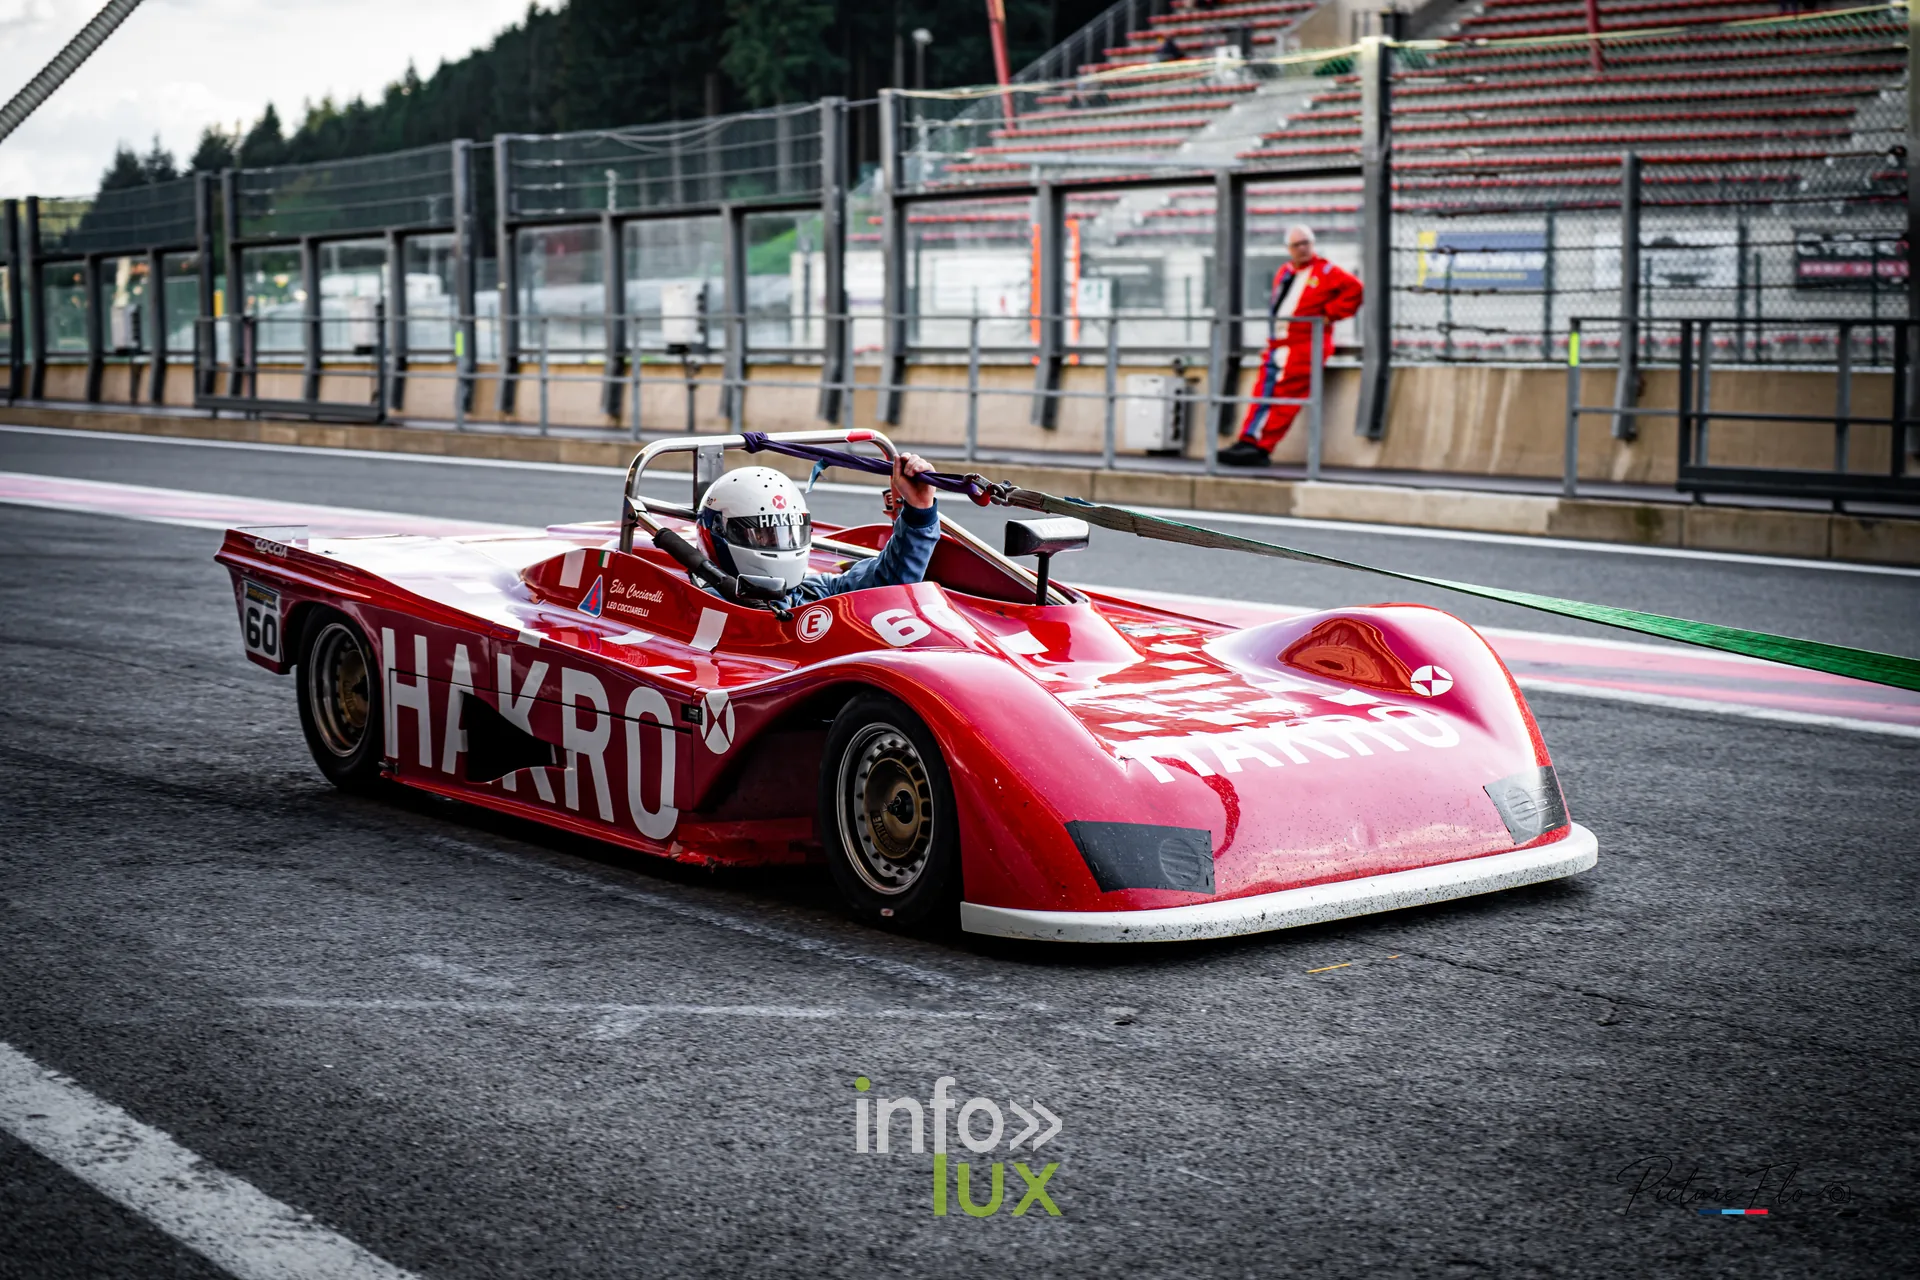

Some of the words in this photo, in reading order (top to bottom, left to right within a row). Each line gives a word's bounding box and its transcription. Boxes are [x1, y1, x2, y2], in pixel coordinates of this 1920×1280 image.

[759, 513, 805, 528] HAKRO
[610, 579, 625, 594] Elio
[606, 601, 618, 611] LEO
[617, 602, 650, 617] COCCIARELLI
[246, 606, 277, 656] 60
[381, 627, 679, 840] HAKRO
[1124, 705, 1460, 784] HAKRO
